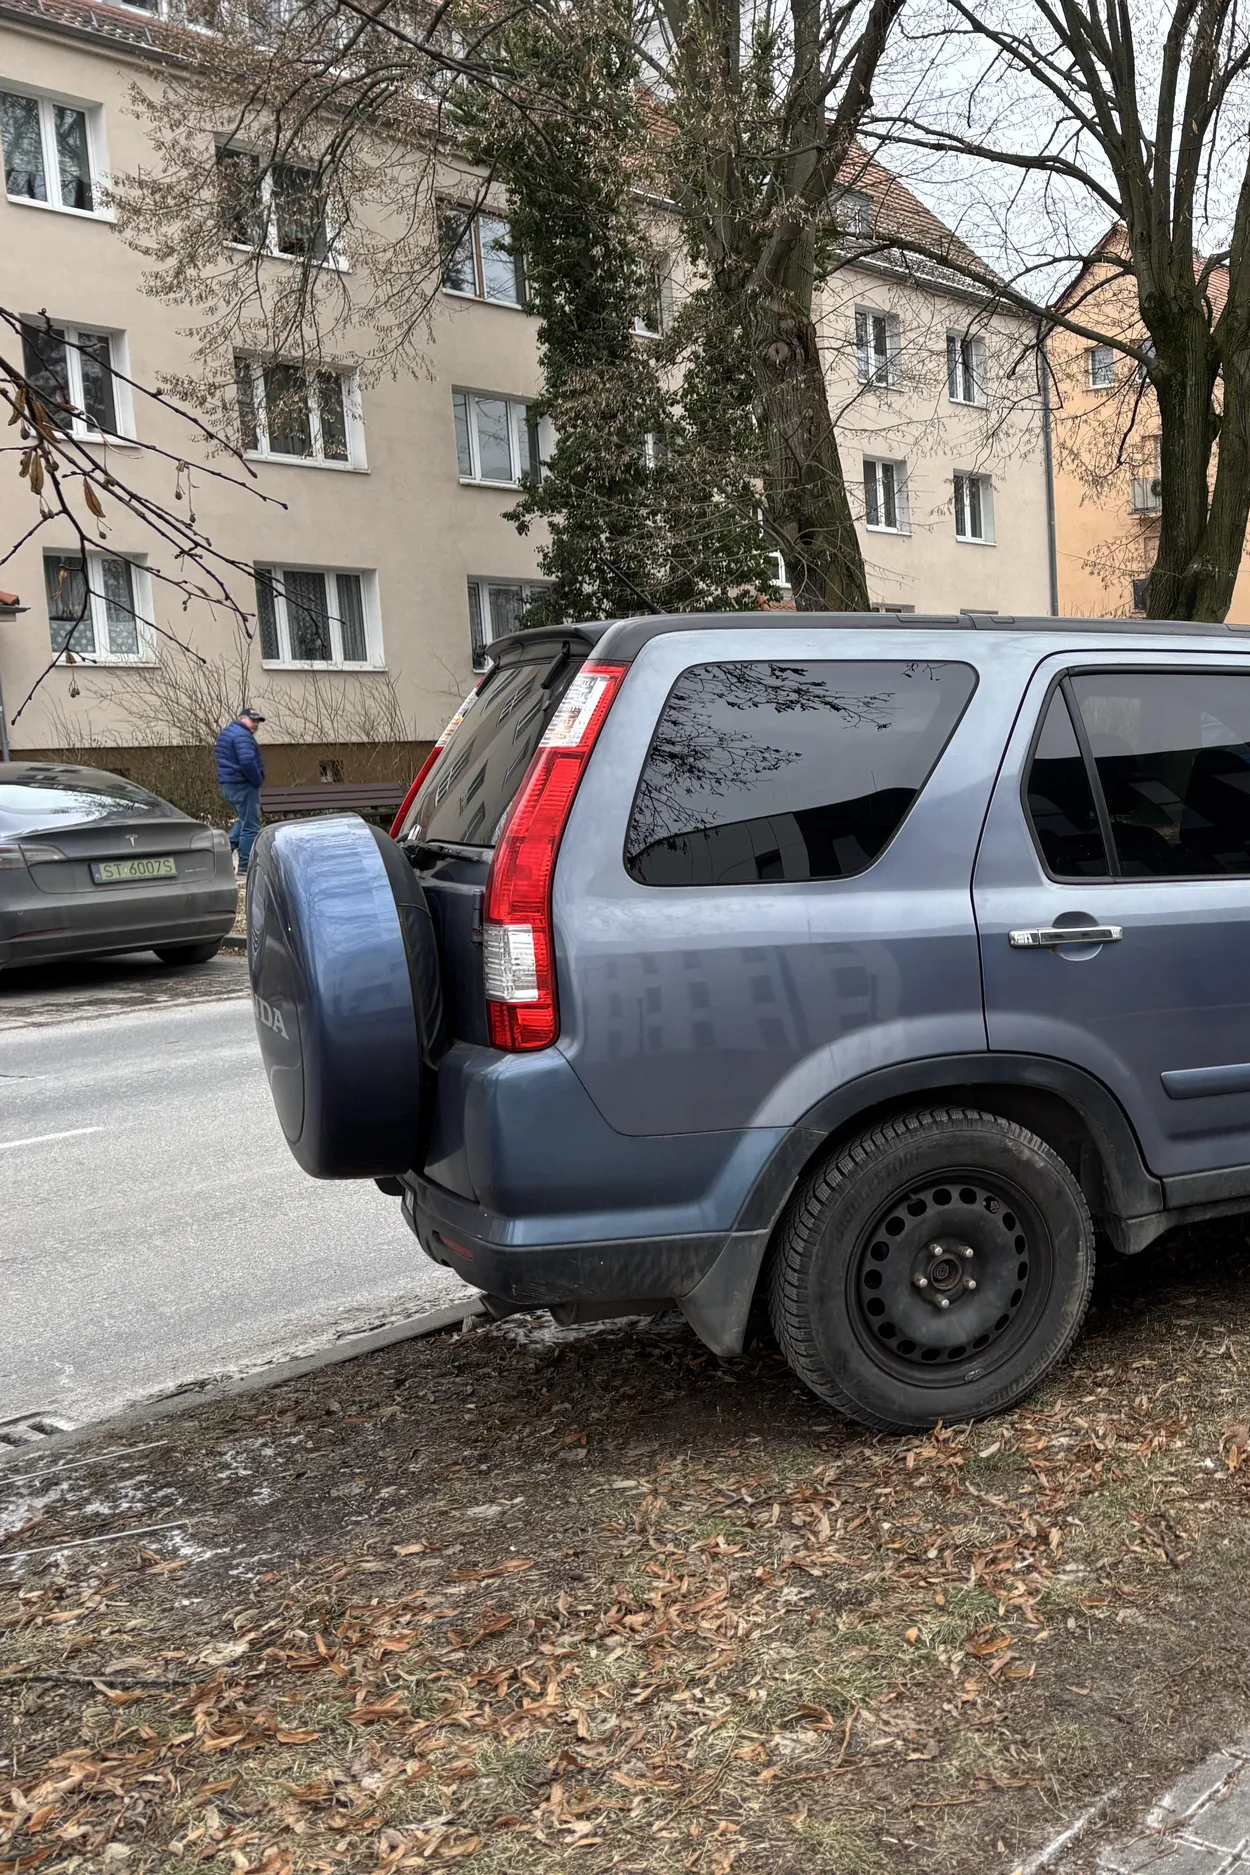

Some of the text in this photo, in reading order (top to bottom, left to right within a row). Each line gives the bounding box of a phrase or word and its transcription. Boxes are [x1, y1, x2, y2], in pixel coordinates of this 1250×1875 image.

[103, 859, 173, 878] ST 6007S
[254, 993, 290, 1041] NDA
